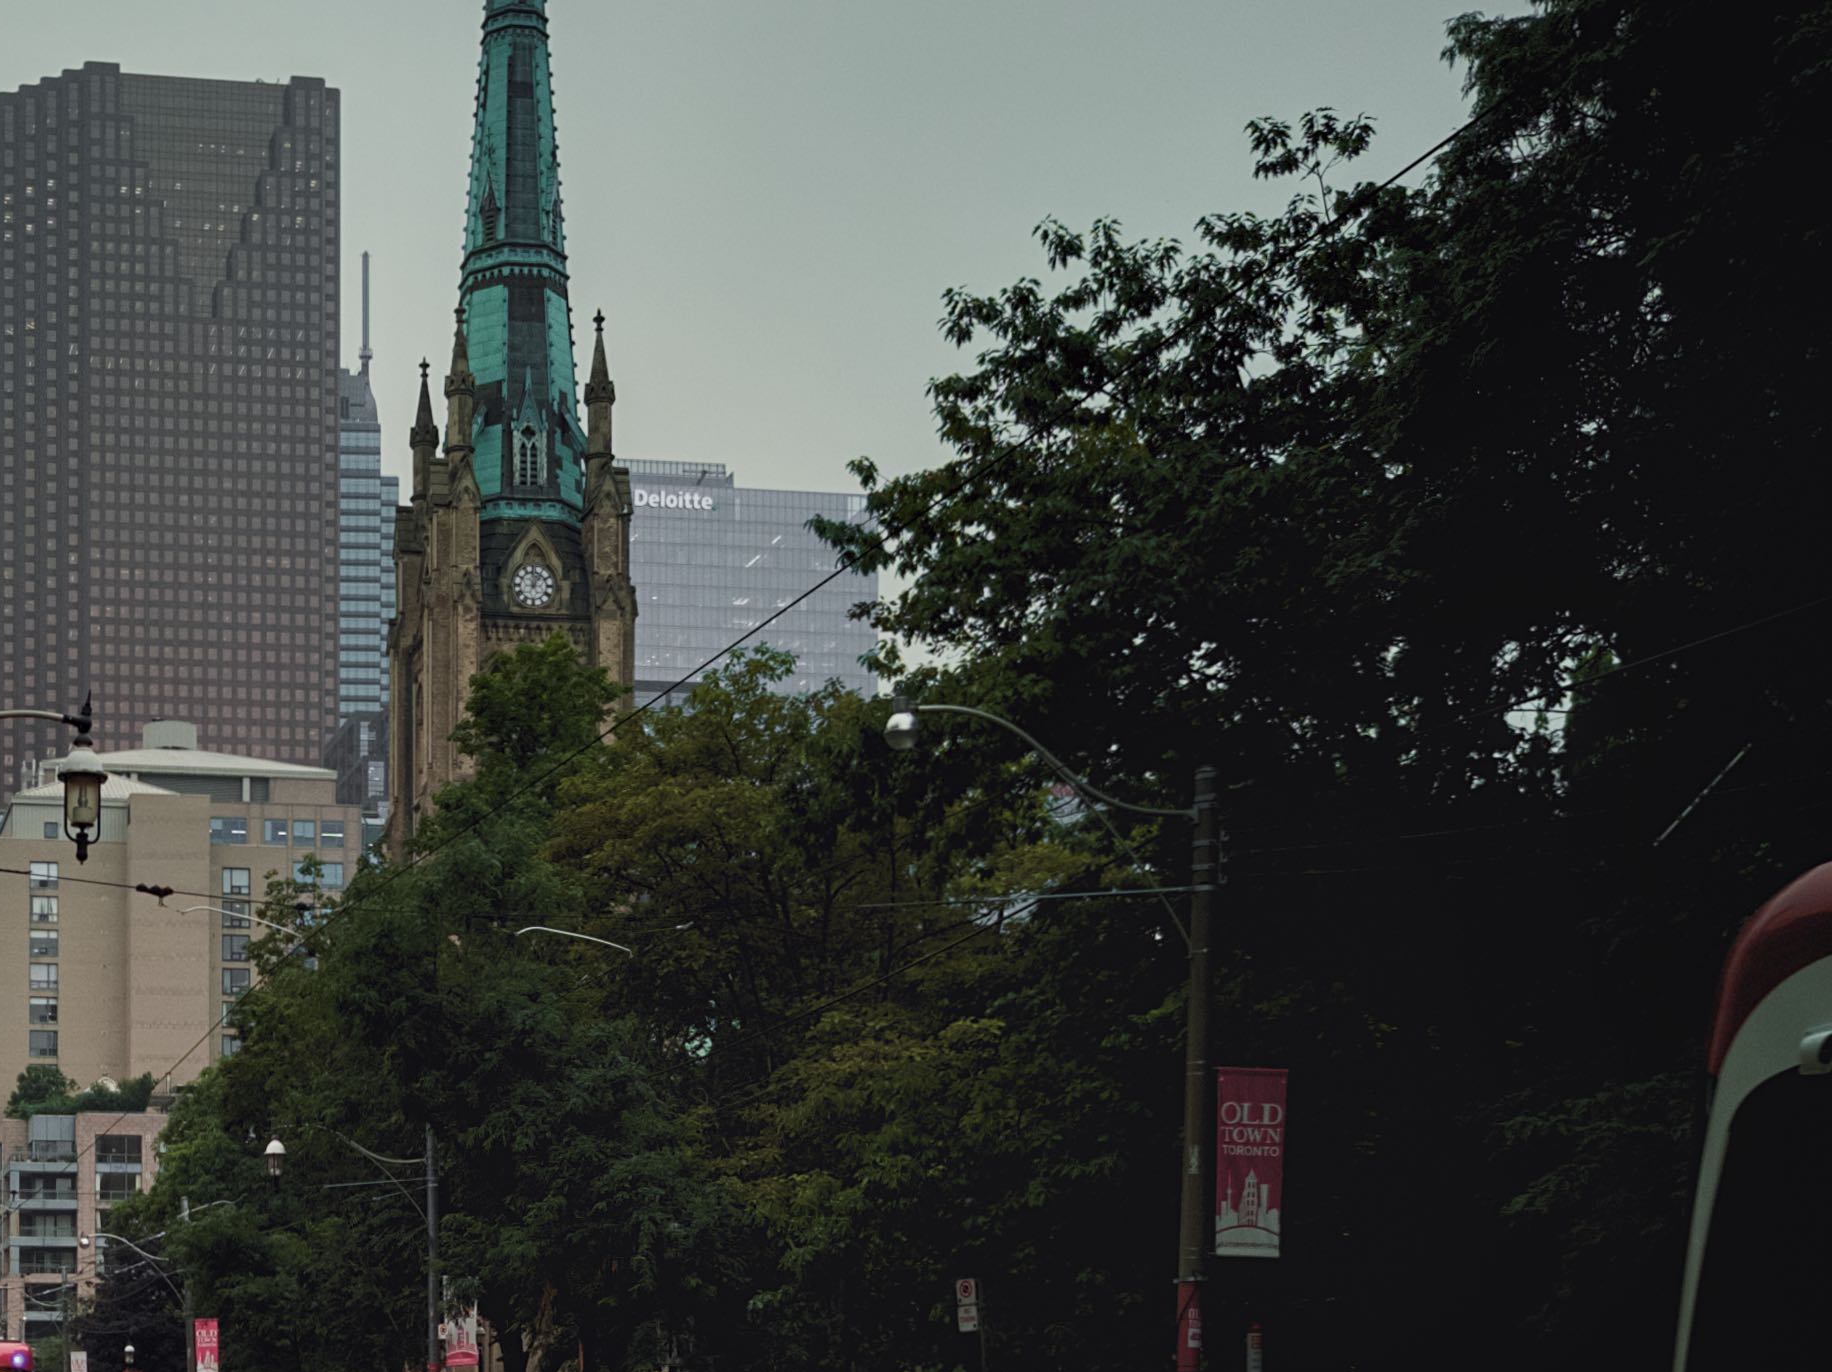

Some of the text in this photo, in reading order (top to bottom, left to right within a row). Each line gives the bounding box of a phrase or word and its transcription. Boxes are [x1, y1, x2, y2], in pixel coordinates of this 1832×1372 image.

[633, 488, 713, 510] Deloitte
[1220, 1101, 1283, 1125] OLD
[1221, 1126, 1281, 1144] TOWN
[1222, 1144, 1280, 1158] TORONTO
